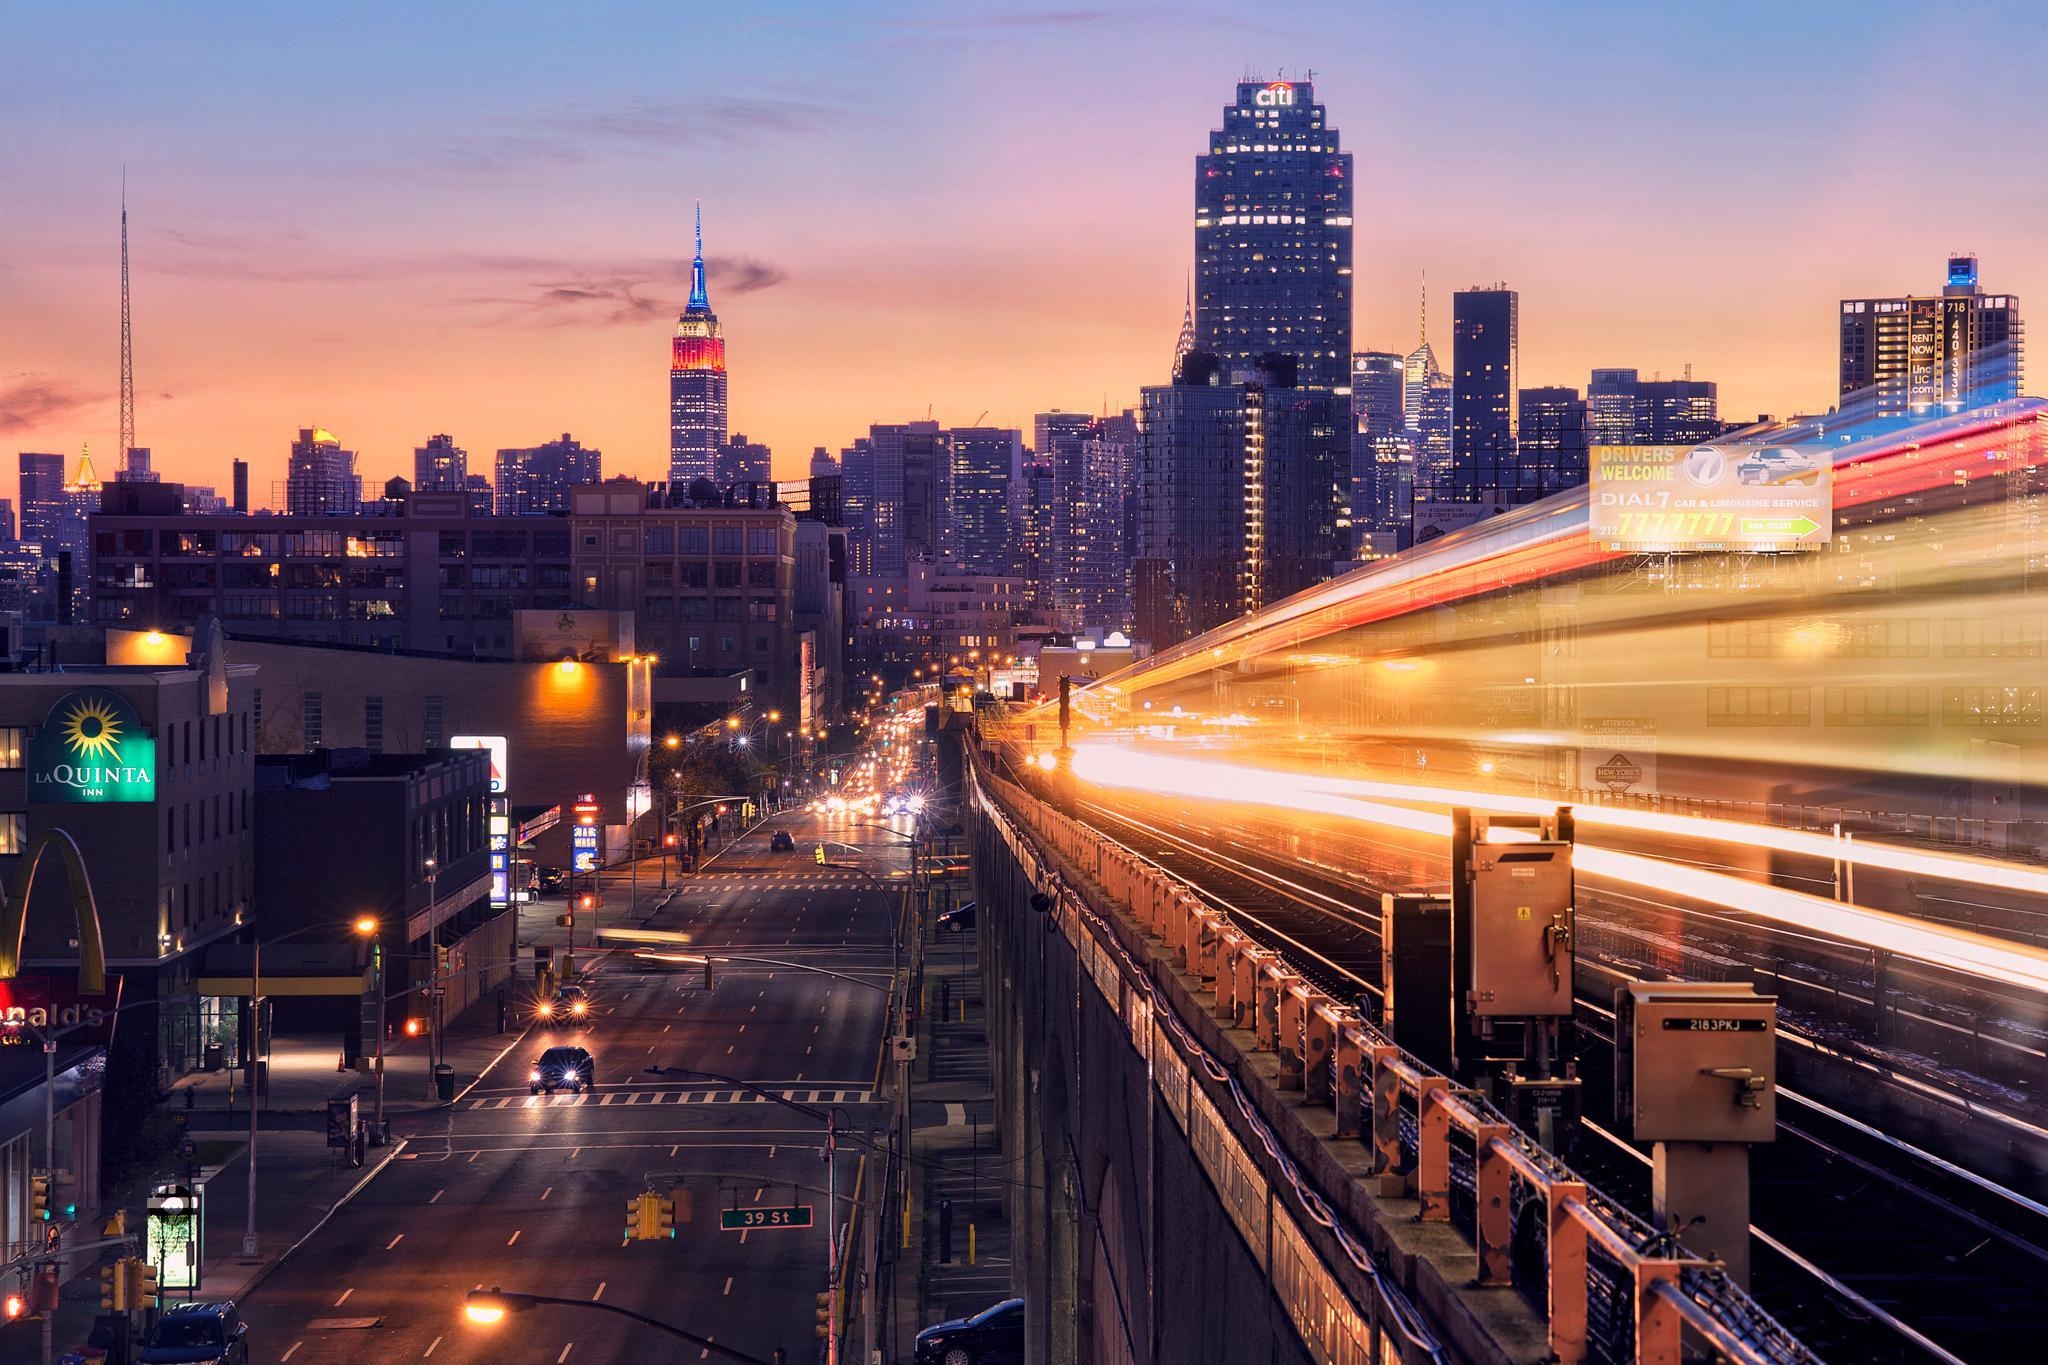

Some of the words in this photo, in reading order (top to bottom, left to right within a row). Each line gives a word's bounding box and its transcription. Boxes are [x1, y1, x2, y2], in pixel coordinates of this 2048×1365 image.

[1256, 86, 1293, 106] citi
[1947, 302, 1966, 313] 718
[1911, 334, 1934, 343] RENT
[1911, 346, 1934, 355] NOW
[1912, 365, 1932, 374] Linc
[1600, 446, 1675, 464] DRIVERS
[1600, 465, 1675, 481] WELCOME
[1674, 498, 1697, 508] CAR
[1699, 498, 1708, 508] &
[1710, 498, 1769, 508] LIMOUSINE
[1772, 498, 1819, 508] SERVICE
[1600, 526, 1618, 536] 212
[1602, 719, 1636, 727] ATTENTION
[35, 773, 53, 784] LA
[53, 764, 151, 788] QUINTA
[1598, 768, 1615, 776] NEW
[82, 788, 104, 797] INN
[574, 838, 597, 848] WASH
[744, 1212, 765, 1225] 39
[771, 1211, 790, 1224] St
